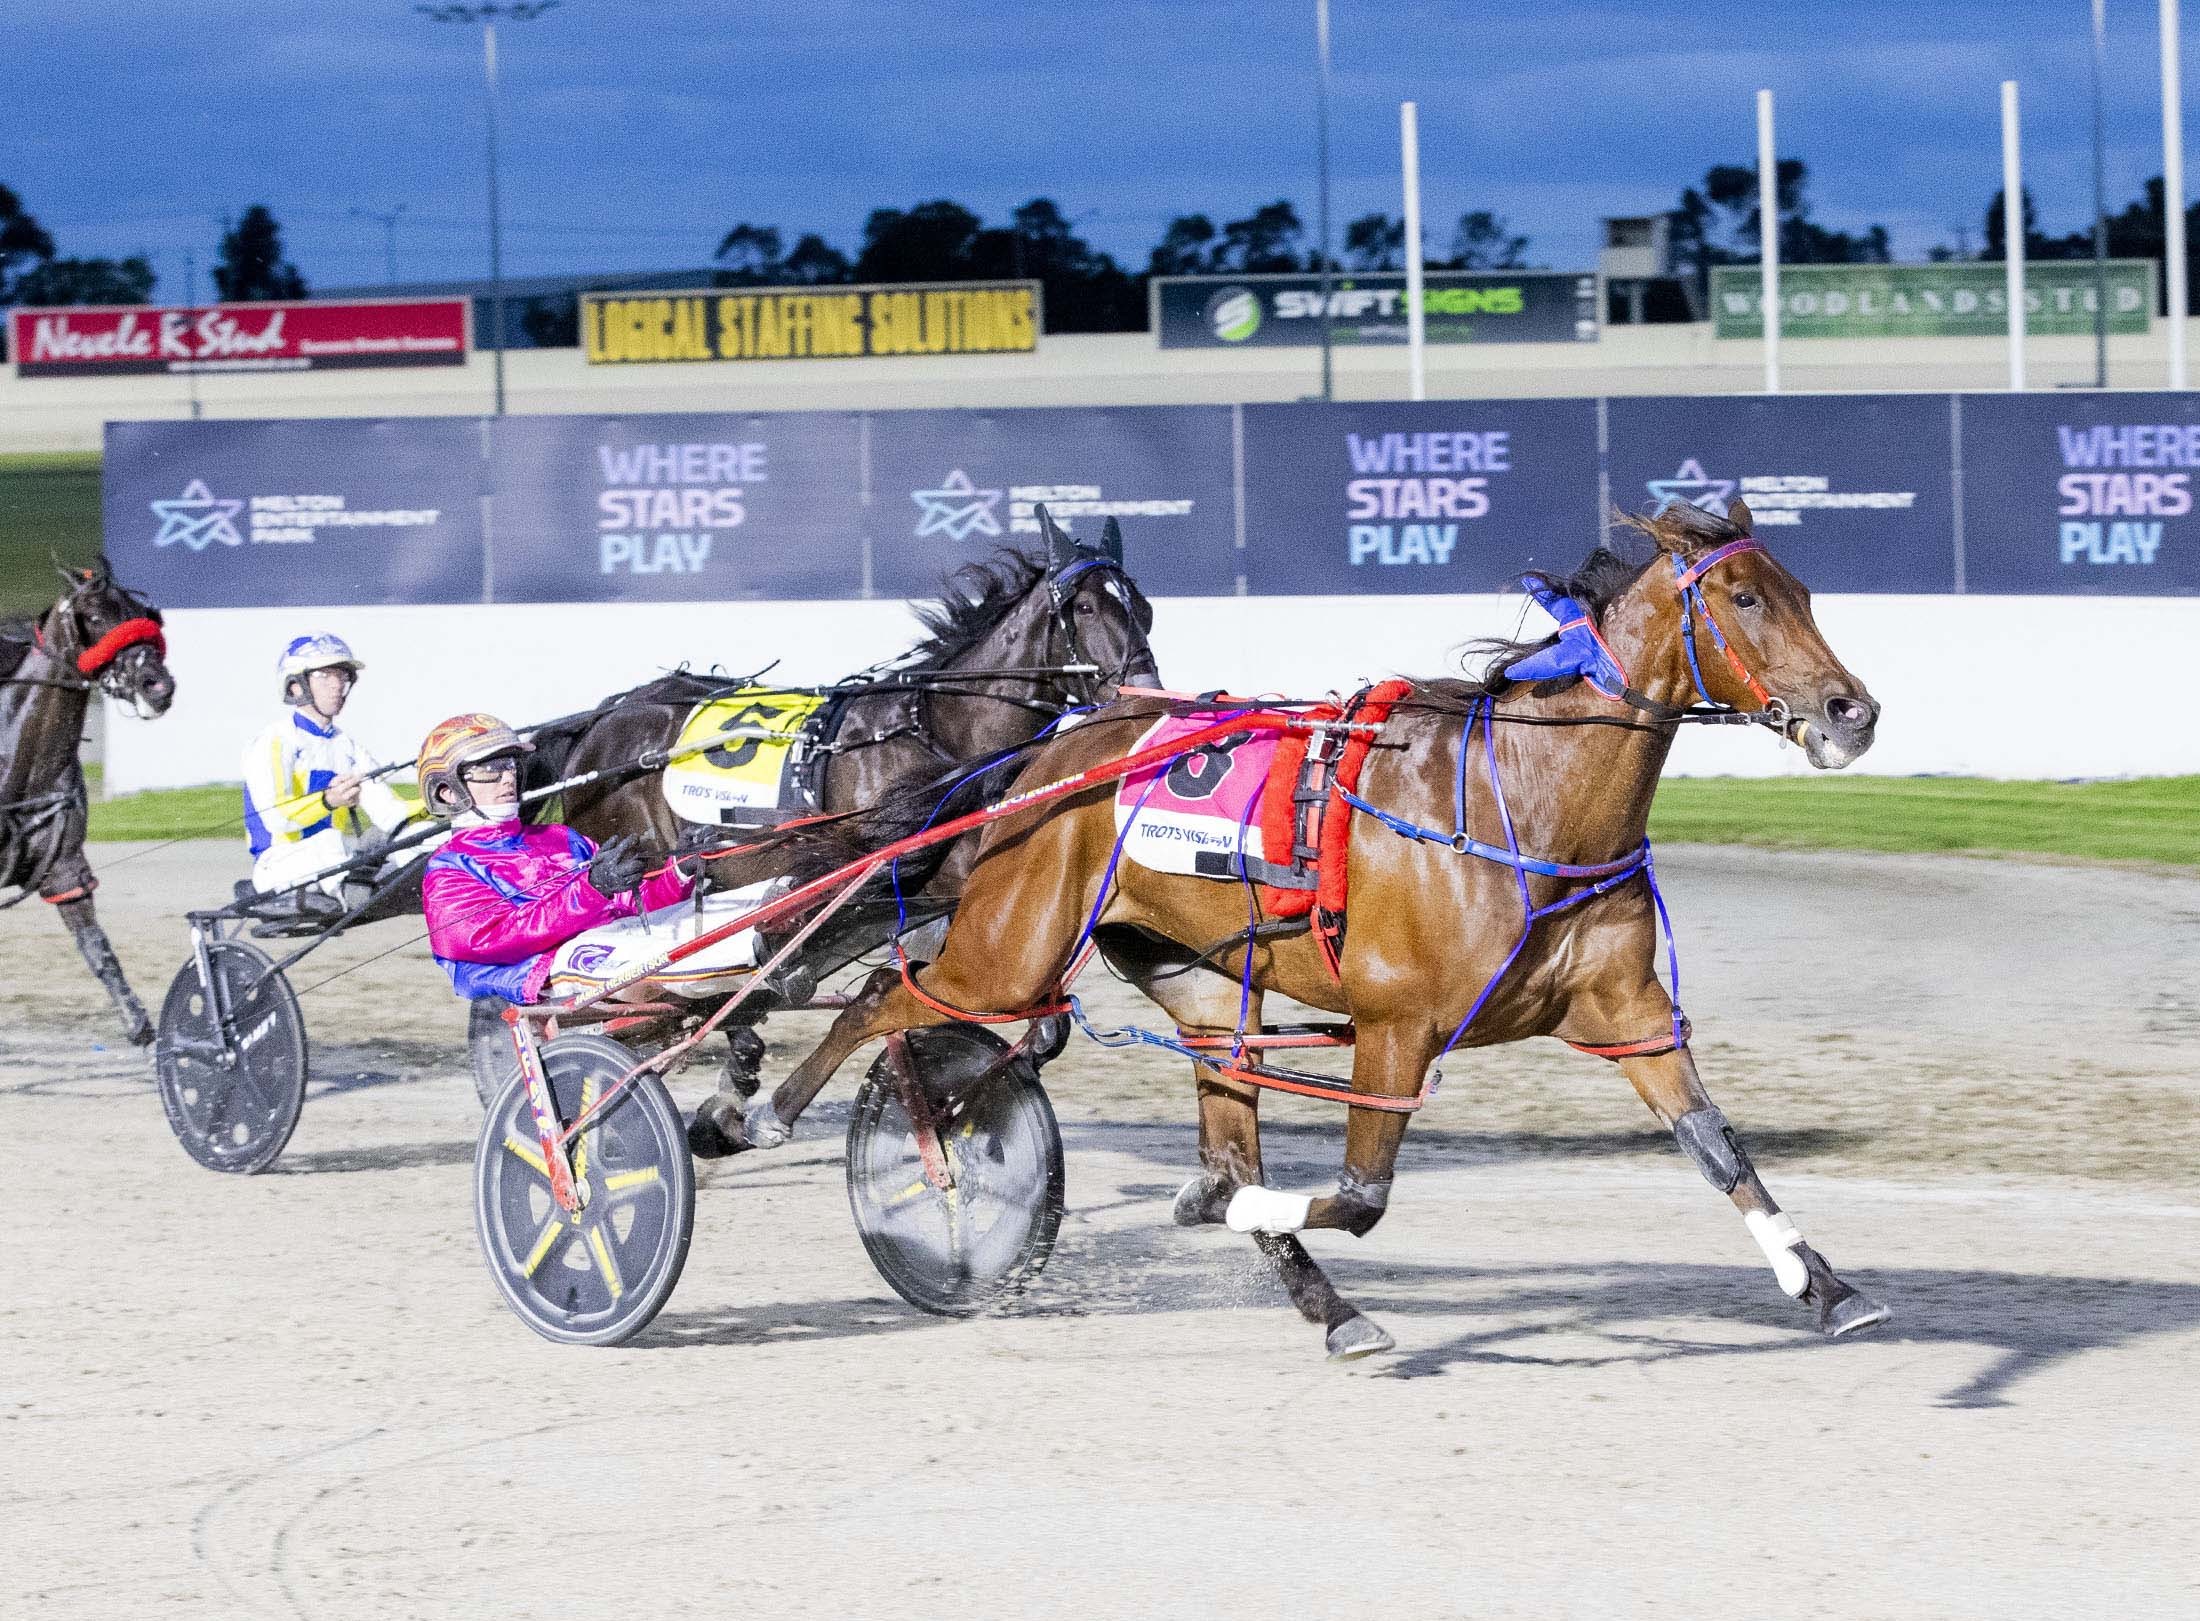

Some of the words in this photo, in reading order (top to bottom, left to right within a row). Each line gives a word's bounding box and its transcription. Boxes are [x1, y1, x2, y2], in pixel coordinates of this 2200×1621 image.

[158, 312, 192, 357] R
[195, 311, 287, 357] Stud
[588, 300, 713, 361] LOGICAL
[718, 295, 864, 358] STAFFING
[870, 290, 1036, 354] SOLUTIONS
[599, 443, 767, 484] WHERE
[1346, 432, 1511, 472] WHERE
[599, 488, 745, 529] STARS
[1348, 477, 1490, 519] STARS
[2058, 473, 2192, 516] STARS
[600, 534, 712, 574] PLAY
[1350, 524, 1458, 566] PLAY
[2060, 522, 2163, 564] PLAY
[704, 702, 786, 769] 5
[1166, 730, 1256, 799] 8
